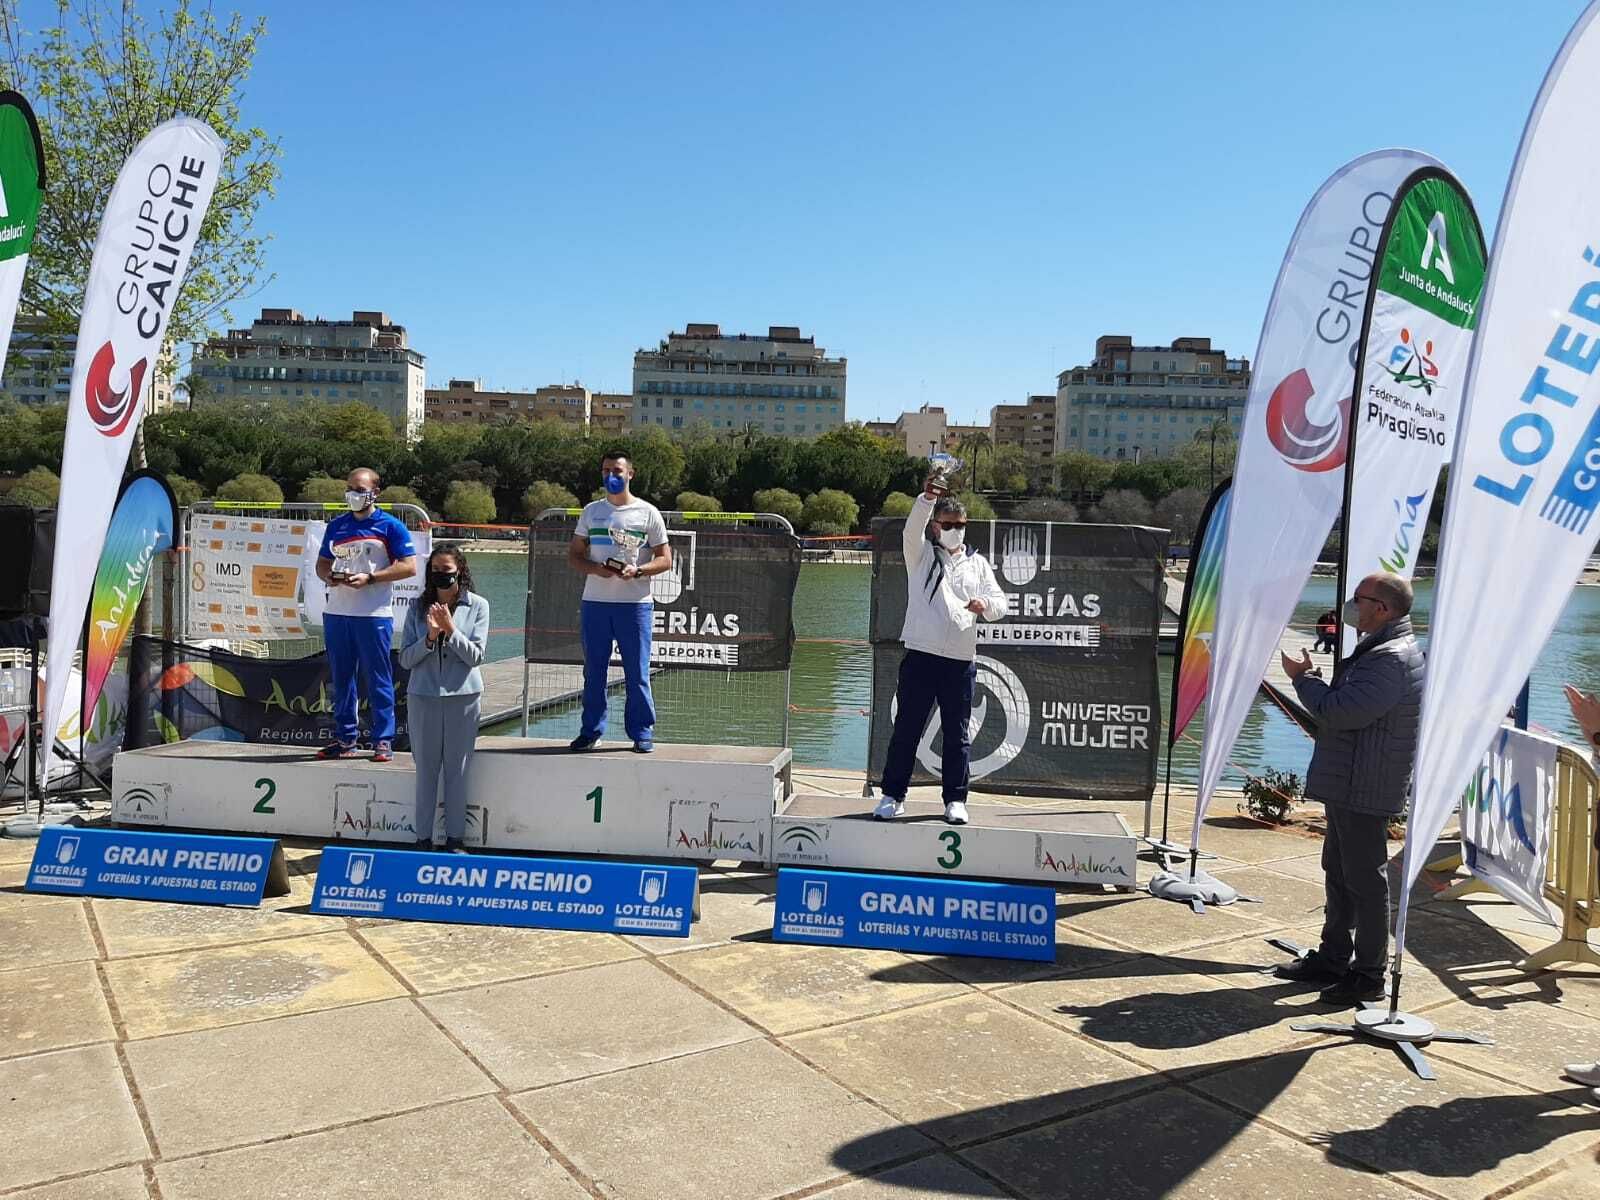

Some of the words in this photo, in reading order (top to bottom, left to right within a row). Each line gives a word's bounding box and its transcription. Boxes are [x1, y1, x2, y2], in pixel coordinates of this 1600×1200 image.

[117, 163, 172, 315] GRUPO
[137, 155, 205, 339] CALICHE
[1316, 191, 1395, 344] GRUPO
[1399, 266, 1424, 290] Junta
[1425, 280, 1436, 297] de
[1573, 435, 1600, 491] CO
[215, 562, 241, 576] IMD
[1005, 587, 1101, 618] ERÍAS
[652, 607, 740, 637] ERÍAS
[992, 629, 1008, 639] EL
[1013, 630, 1081, 640] DEPORTE
[658, 647, 721, 659] DEPORTE
[1041, 701, 1150, 723] UNIVERSO
[260, 727, 313, 743] Región
[1041, 722, 1149, 750] MUJER
[253, 778, 277, 814] 2
[586, 786, 604, 823] 1
[341, 811, 417, 834] Andalucía
[676, 829, 756, 853] Andalucía
[936, 830, 963, 869] 3
[35, 864, 88, 877] LOTERÍAS
[104, 845, 166, 868] GRAN
[173, 850, 263, 873] PREMIO
[1041, 851, 1129, 876] Andalucía
[98, 871, 142, 885] LOTERÍAS
[143, 875, 150, 885] Y
[151, 876, 199, 889] APUESTAS
[200, 879, 218, 890] DEL
[220, 880, 257, 893] ESTADO
[321, 885, 387, 900] LOTERÍAS
[417, 865, 487, 888] GRAN
[495, 869, 593, 894] PREMIO
[396, 890, 455, 906] LOTERÍAS
[456, 896, 465, 907] Y
[467, 896, 530, 912] APUESTAS
[531, 900, 554, 913] DEL
[557, 900, 604, 915] ESTADO
[615, 903, 684, 919] LOTERÍAS
[860, 891, 934, 917] GRAN
[943, 898, 1048, 926] PREMIO
[781, 911, 845, 927] LOTERÍAS
[858, 919, 910, 936] LOTERÍAS
[912, 925, 922, 937] Y
[923, 926, 979, 942] APUESTAS
[981, 930, 1003, 943] DEL
[1004, 931, 1048, 947] ESTADO
